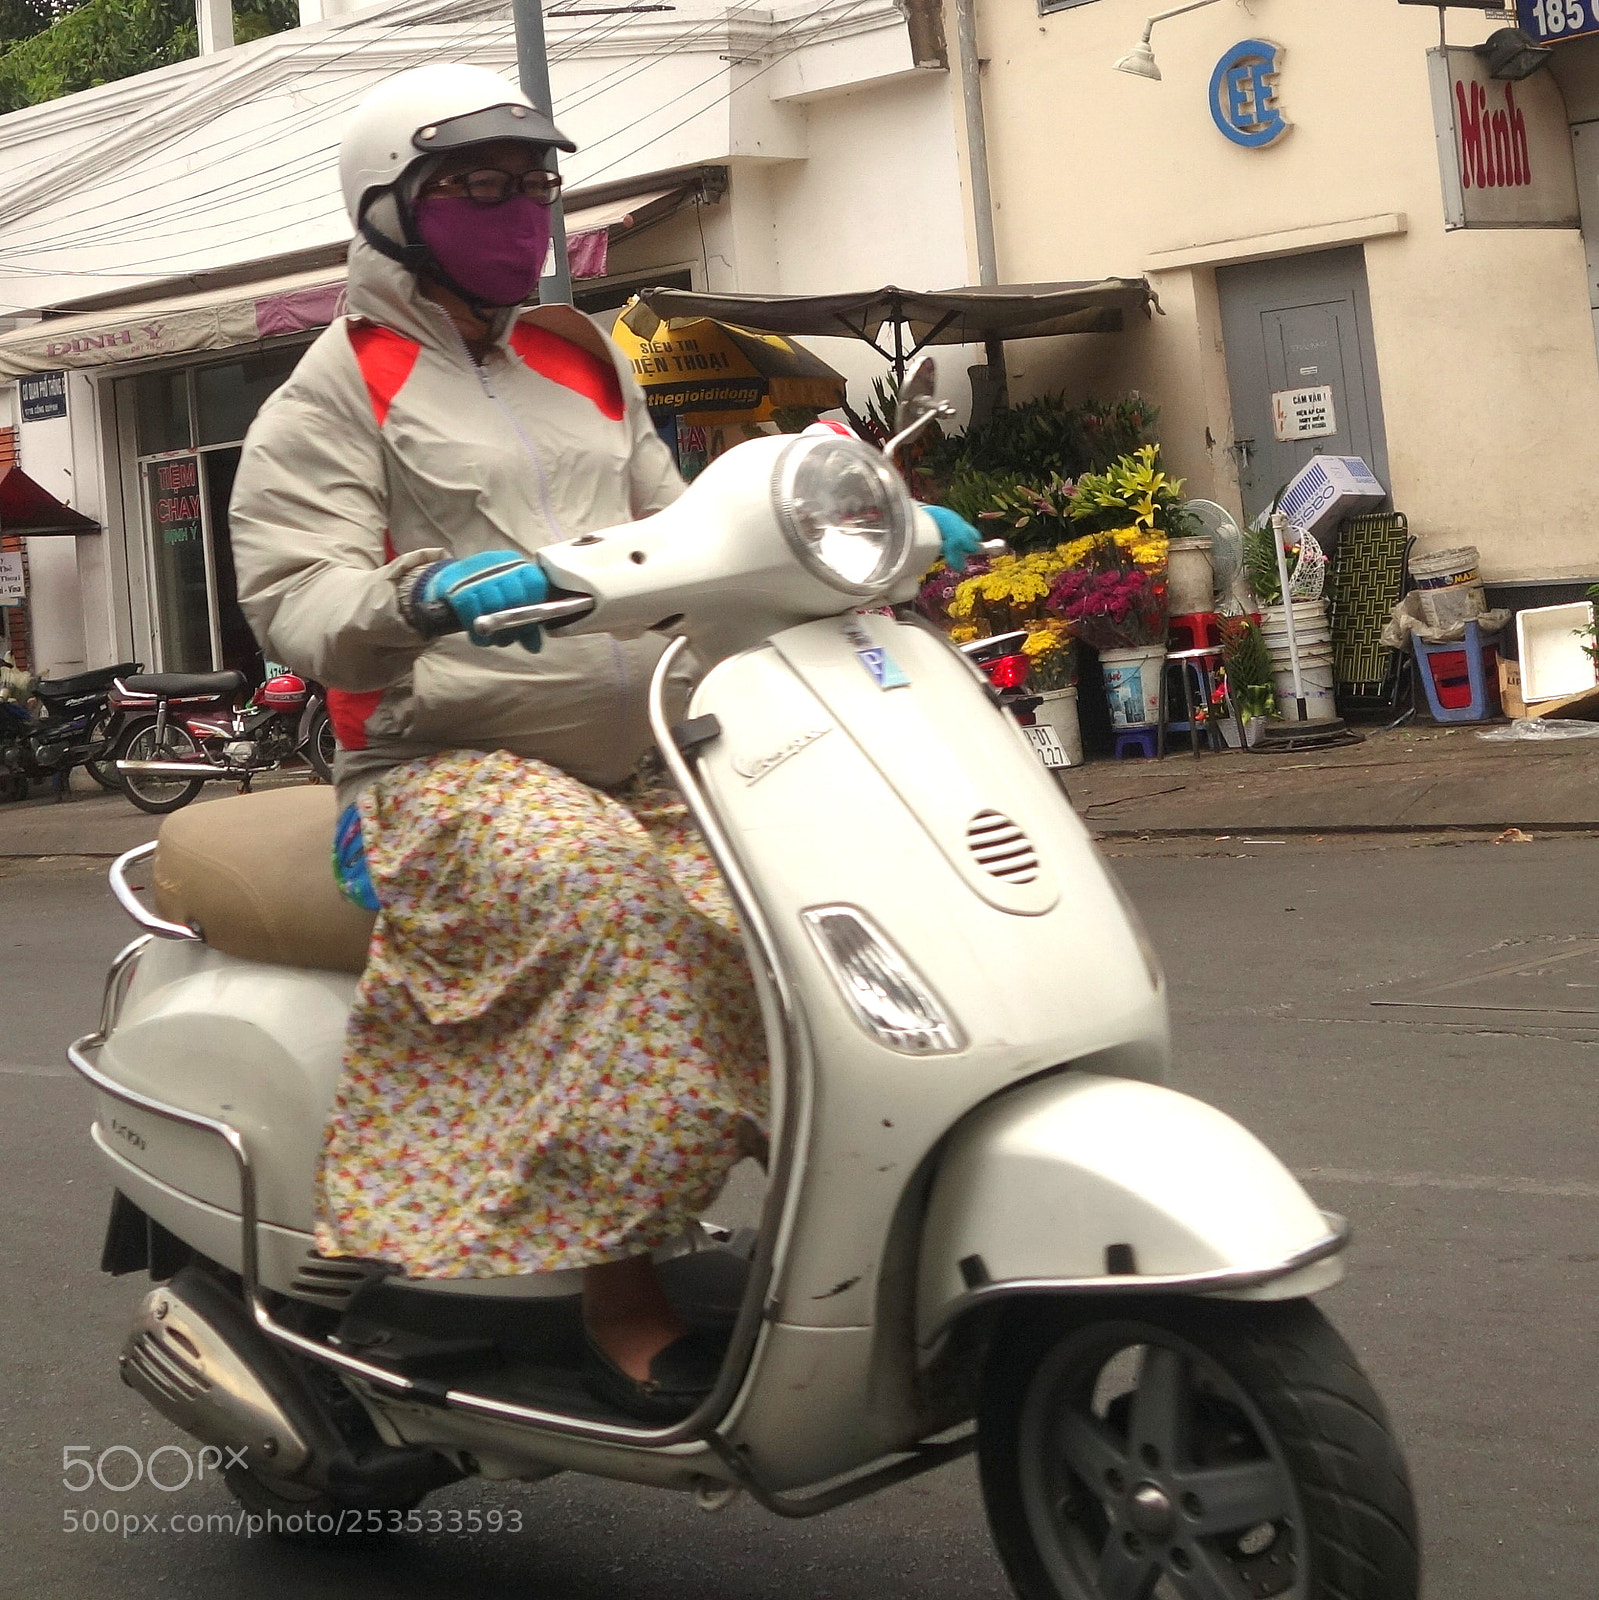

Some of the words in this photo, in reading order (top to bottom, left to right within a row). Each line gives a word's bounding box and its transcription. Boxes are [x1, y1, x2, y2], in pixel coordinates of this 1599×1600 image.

[1533, 0, 1585, 36] 185
[1456, 80, 1531, 189] Minh
[646, 388, 759, 407] thegioididong
[158, 461, 196, 493] TIỆM
[157, 495, 200, 523] CHAY
